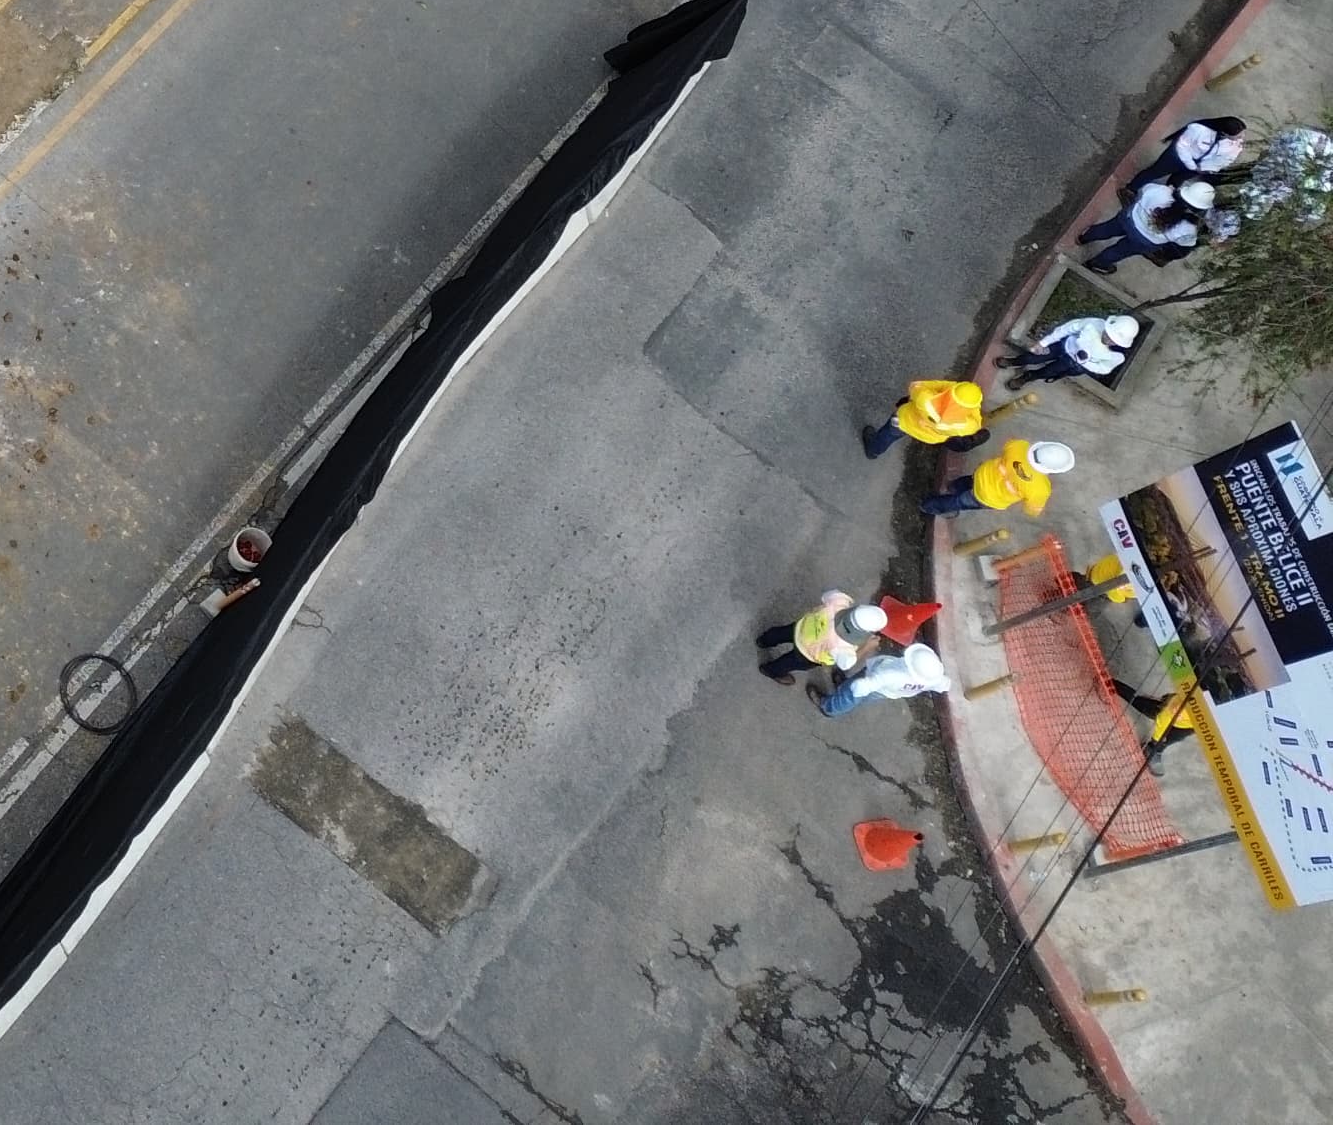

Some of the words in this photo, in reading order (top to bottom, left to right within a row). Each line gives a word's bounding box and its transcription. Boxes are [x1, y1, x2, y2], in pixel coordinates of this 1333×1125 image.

[1223, 469, 1235, 480] Y
[1212, 474, 1245, 532] FRENTE
[1228, 480, 1247, 506] SUS
[1234, 461, 1277, 531] PUENTE
[1263, 489, 1277, 506] LOS
[1113, 517, 1134, 549] CAV
[1291, 546, 1302, 558] DE
[1296, 557, 1333, 621] CONSTRUCCIÓN
[1211, 754, 1247, 818] TEMPORAL
[1240, 820, 1255, 839] DE
[1249, 839, 1284, 902] CARRILES
